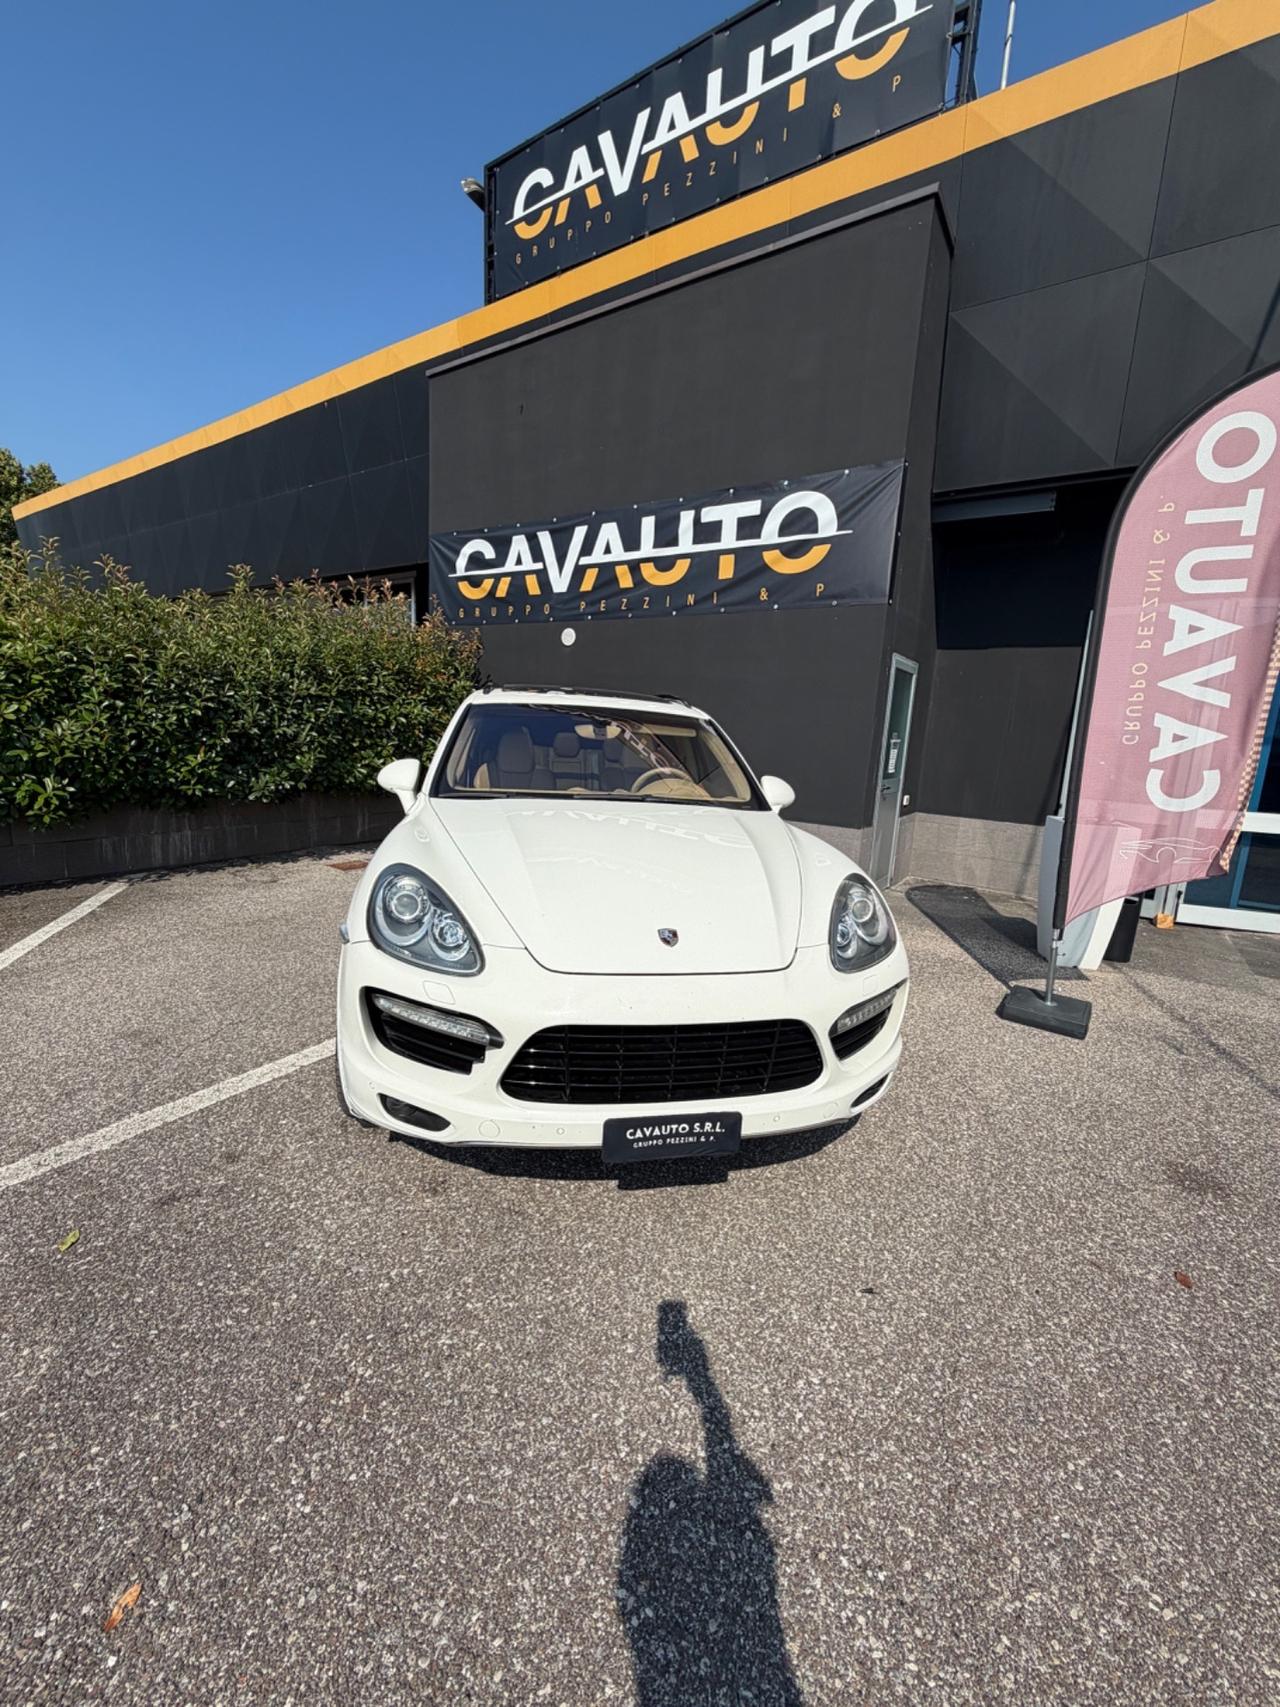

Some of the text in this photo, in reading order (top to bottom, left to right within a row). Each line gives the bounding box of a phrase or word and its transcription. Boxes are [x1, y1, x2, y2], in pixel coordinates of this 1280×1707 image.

[505, 0, 933, 240] CAVAUTO
[515, 75, 902, 265] GRUPPO PEZZINI & P
[448, 490, 853, 600] CAVAUTO
[459, 583, 825, 619] GRUPPO PEZZINI & P
[626, 1121, 725, 1139] CAVAUTO S.R.L.
[633, 1139, 663, 1148] GRUPPO
[666, 1136, 697, 1144] PEZZINI
